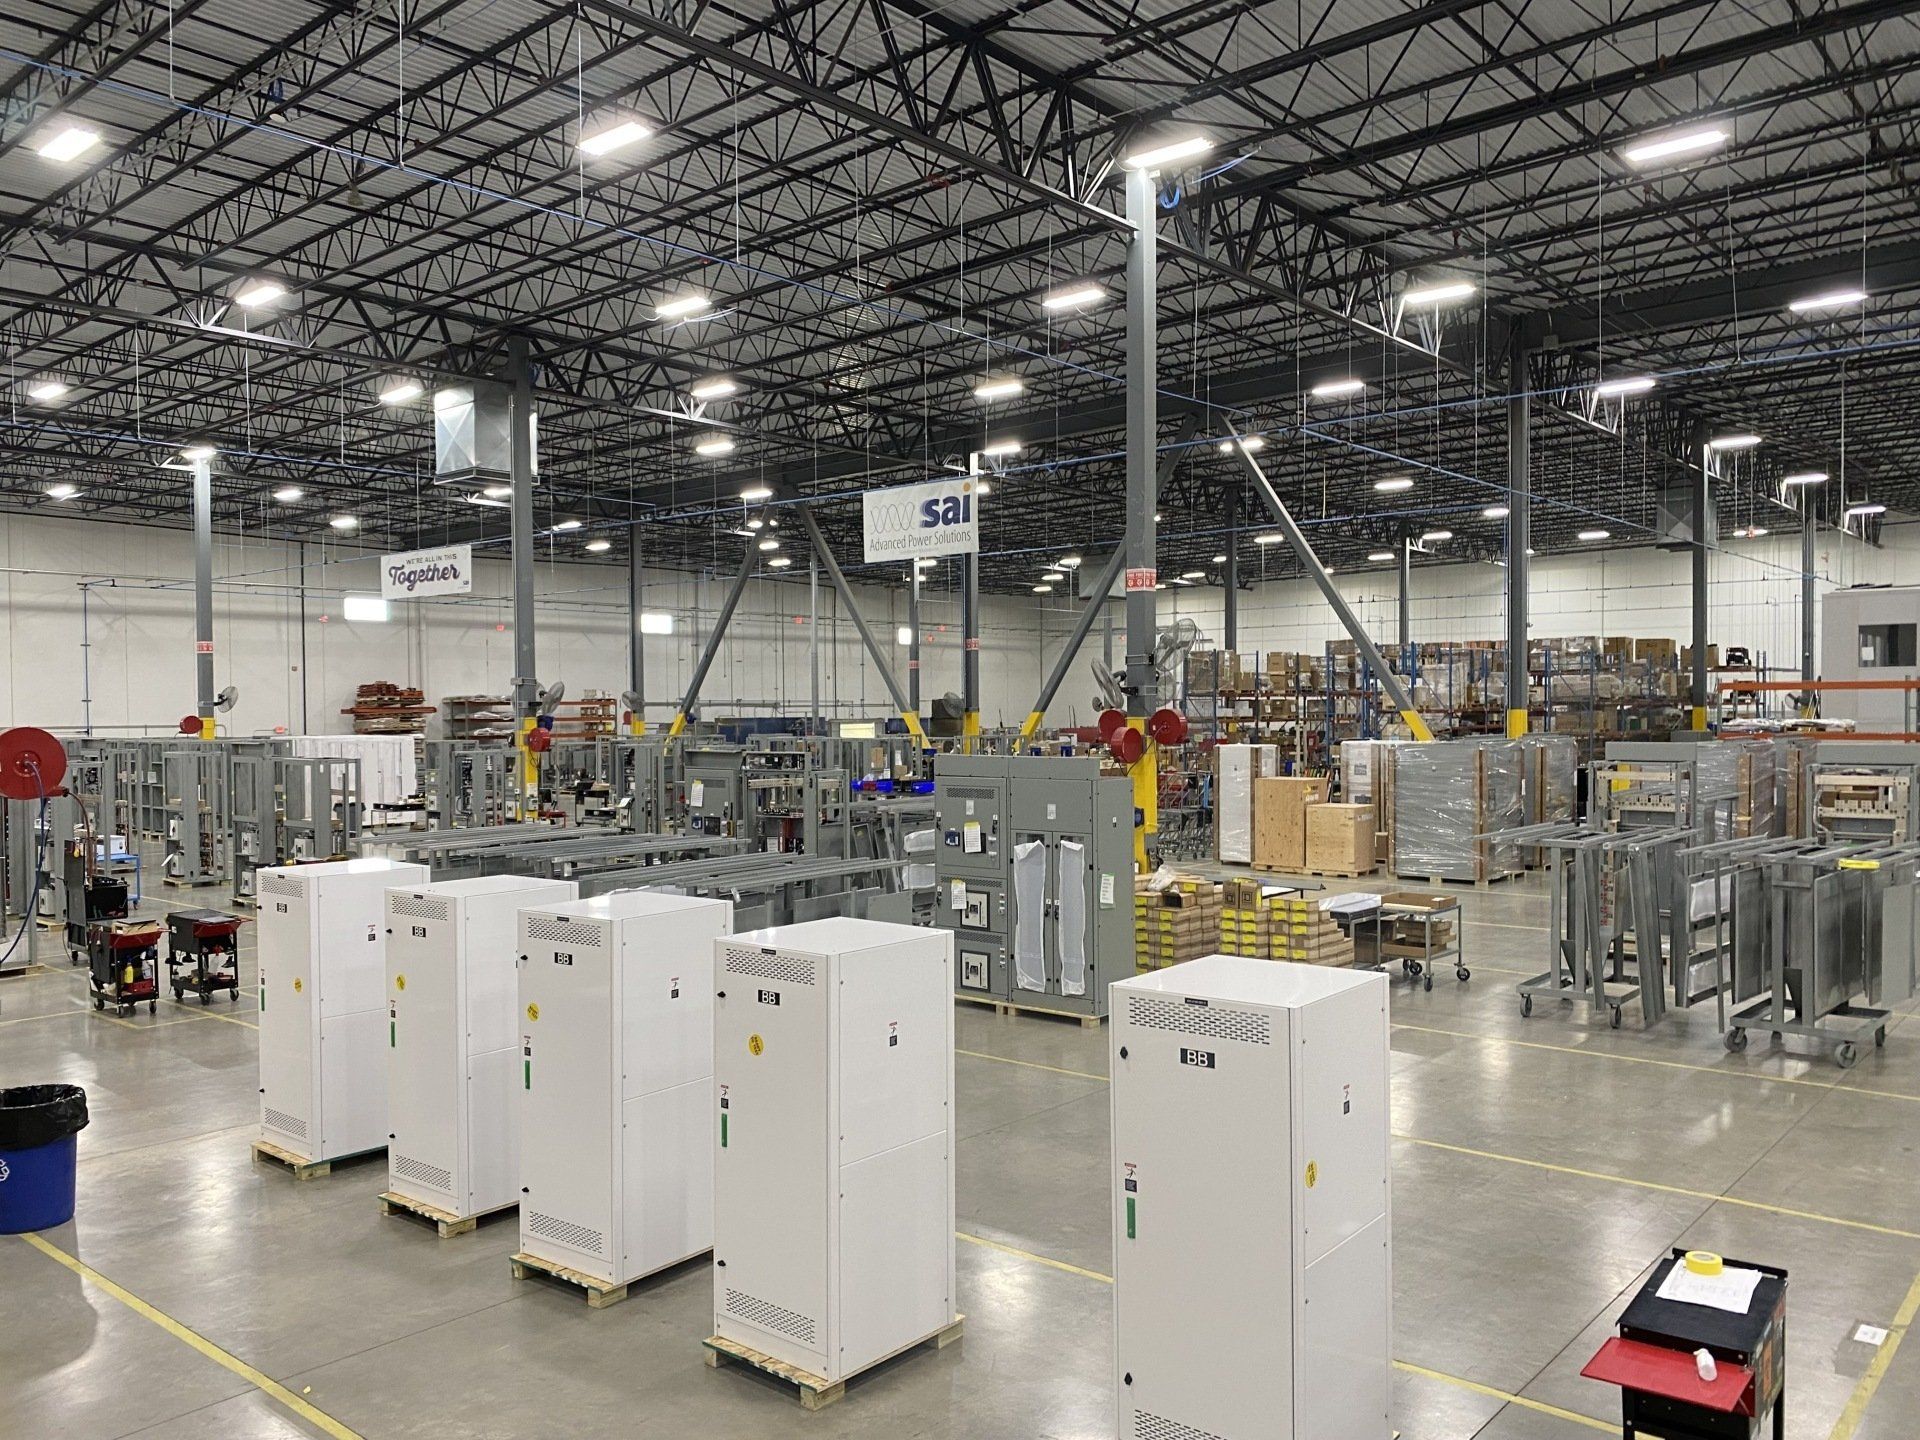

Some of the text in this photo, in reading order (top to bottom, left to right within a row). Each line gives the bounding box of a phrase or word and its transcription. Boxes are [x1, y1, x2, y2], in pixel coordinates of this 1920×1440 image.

[920, 482, 971, 528] sai
[869, 529, 971, 551] Advanced Power Solutions
[389, 563, 460, 591] Together
[761, 991, 776, 1004] BB
[1187, 1050, 1208, 1067] BB
